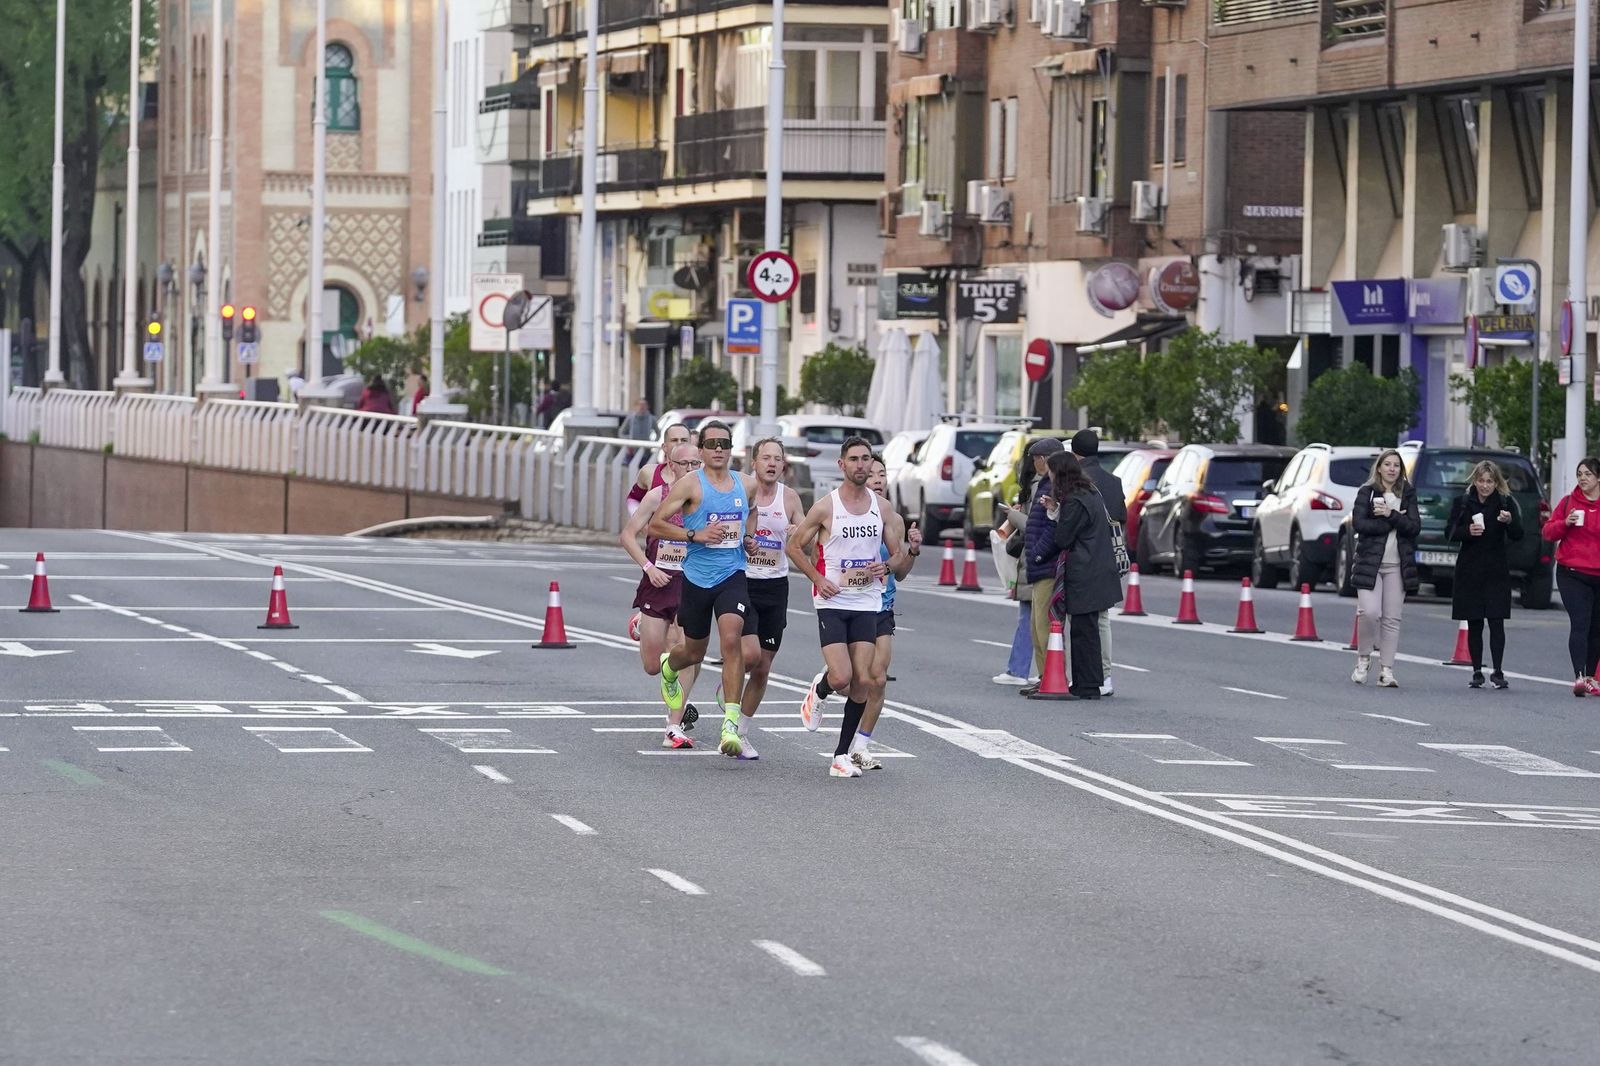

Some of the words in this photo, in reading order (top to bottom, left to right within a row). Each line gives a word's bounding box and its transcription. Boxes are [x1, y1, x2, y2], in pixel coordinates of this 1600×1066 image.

[960, 283, 1016, 298] TINTE
[973, 297, 1009, 322] 5€
[731, 304, 754, 334] P
[842, 525, 878, 538] SUISSE
[745, 556, 776, 567] MATHIAS
